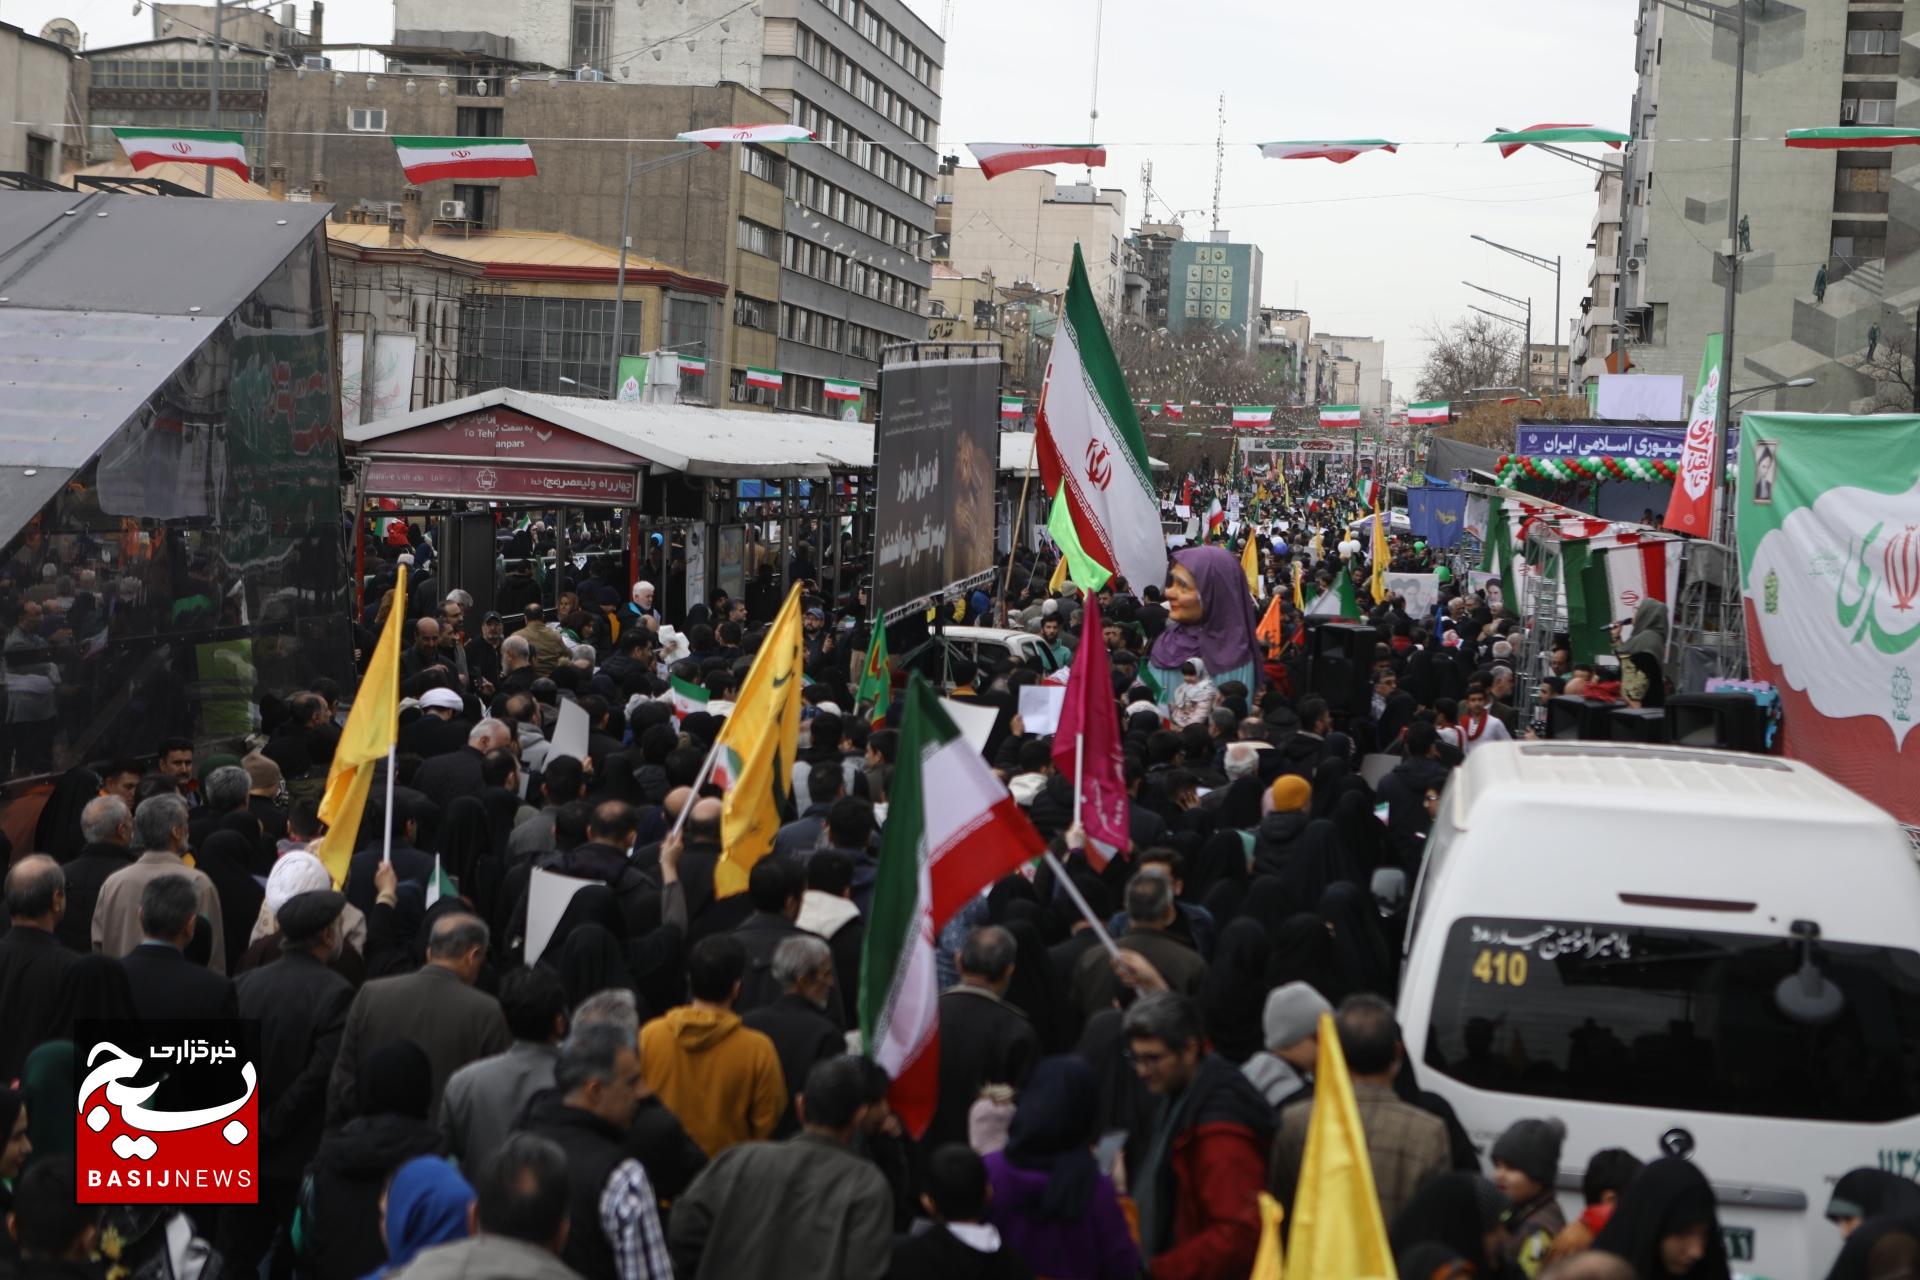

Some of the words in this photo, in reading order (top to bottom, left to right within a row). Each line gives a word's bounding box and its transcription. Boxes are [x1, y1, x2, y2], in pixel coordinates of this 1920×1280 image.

[464, 428, 475, 438] To
[1543, 433, 1577, 456] ایران
[1578, 433, 1632, 457] اسلامی
[1634, 435, 1684, 458] مهوری
[1472, 949, 1528, 987] 410
